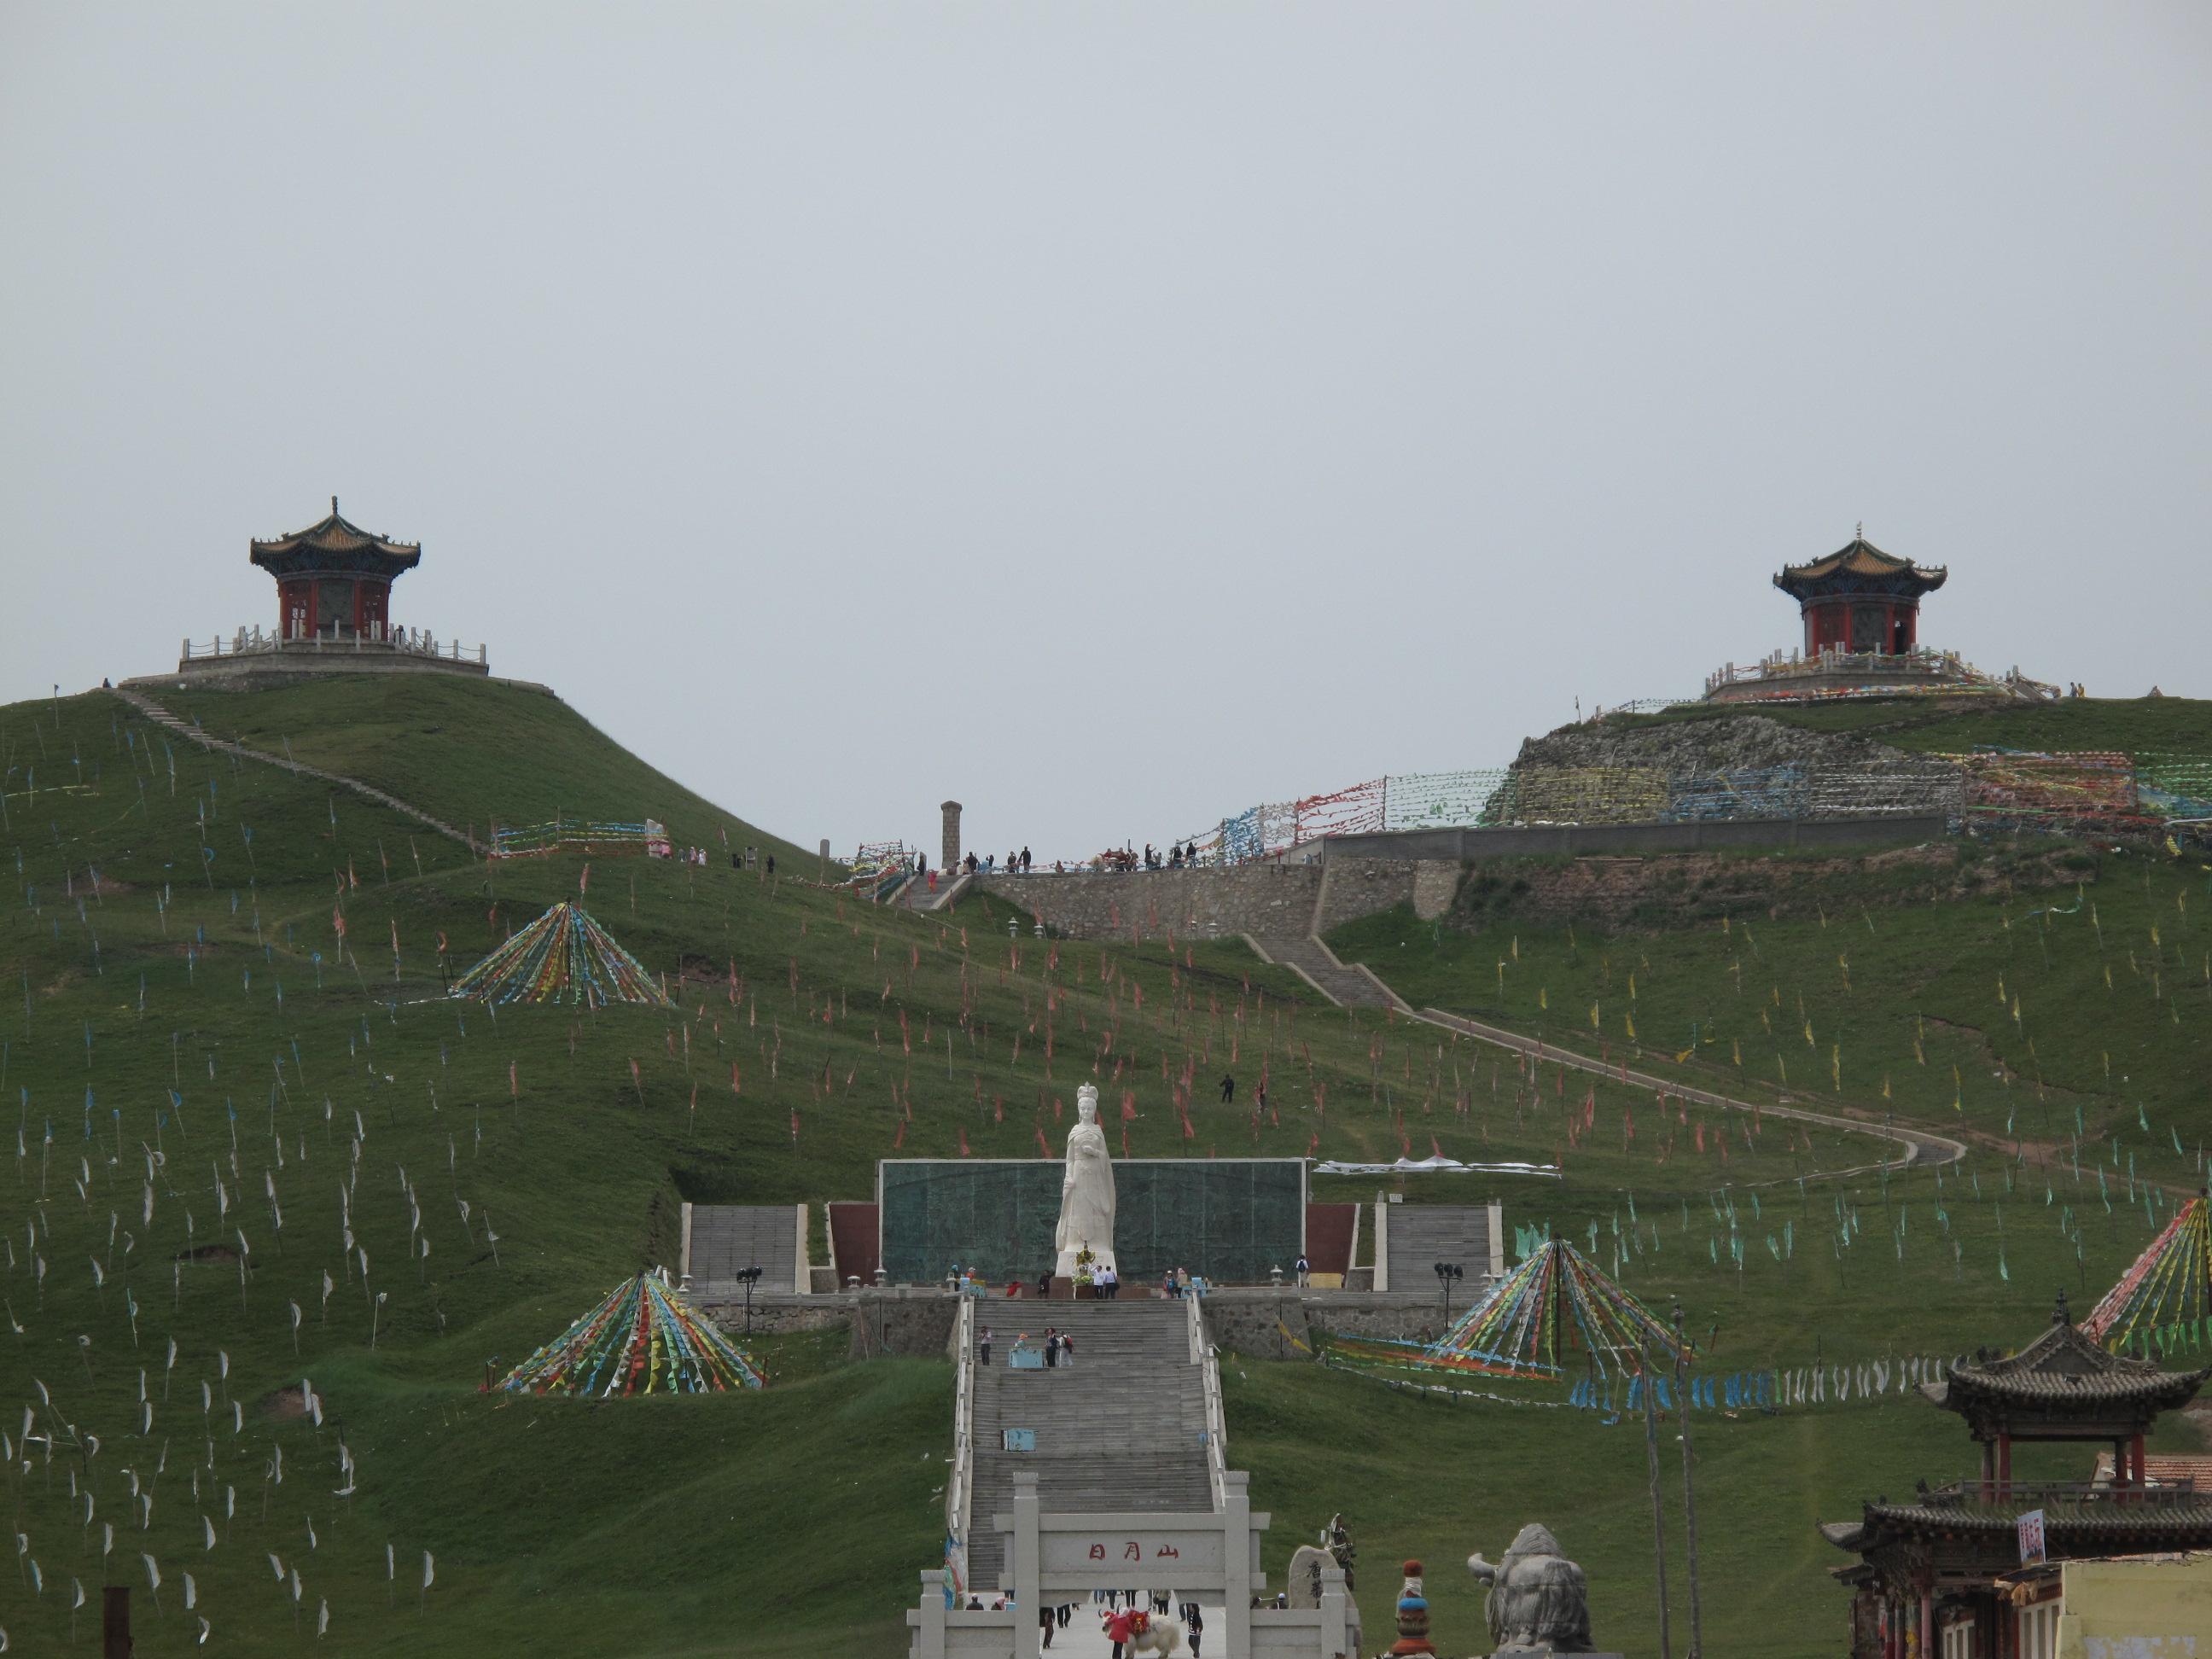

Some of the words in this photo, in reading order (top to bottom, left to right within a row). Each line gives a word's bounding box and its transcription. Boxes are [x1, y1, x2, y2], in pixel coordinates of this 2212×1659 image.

[1089, 1541, 1179, 1561] 日月山
[1307, 1560, 1324, 1610] 唐蕃
